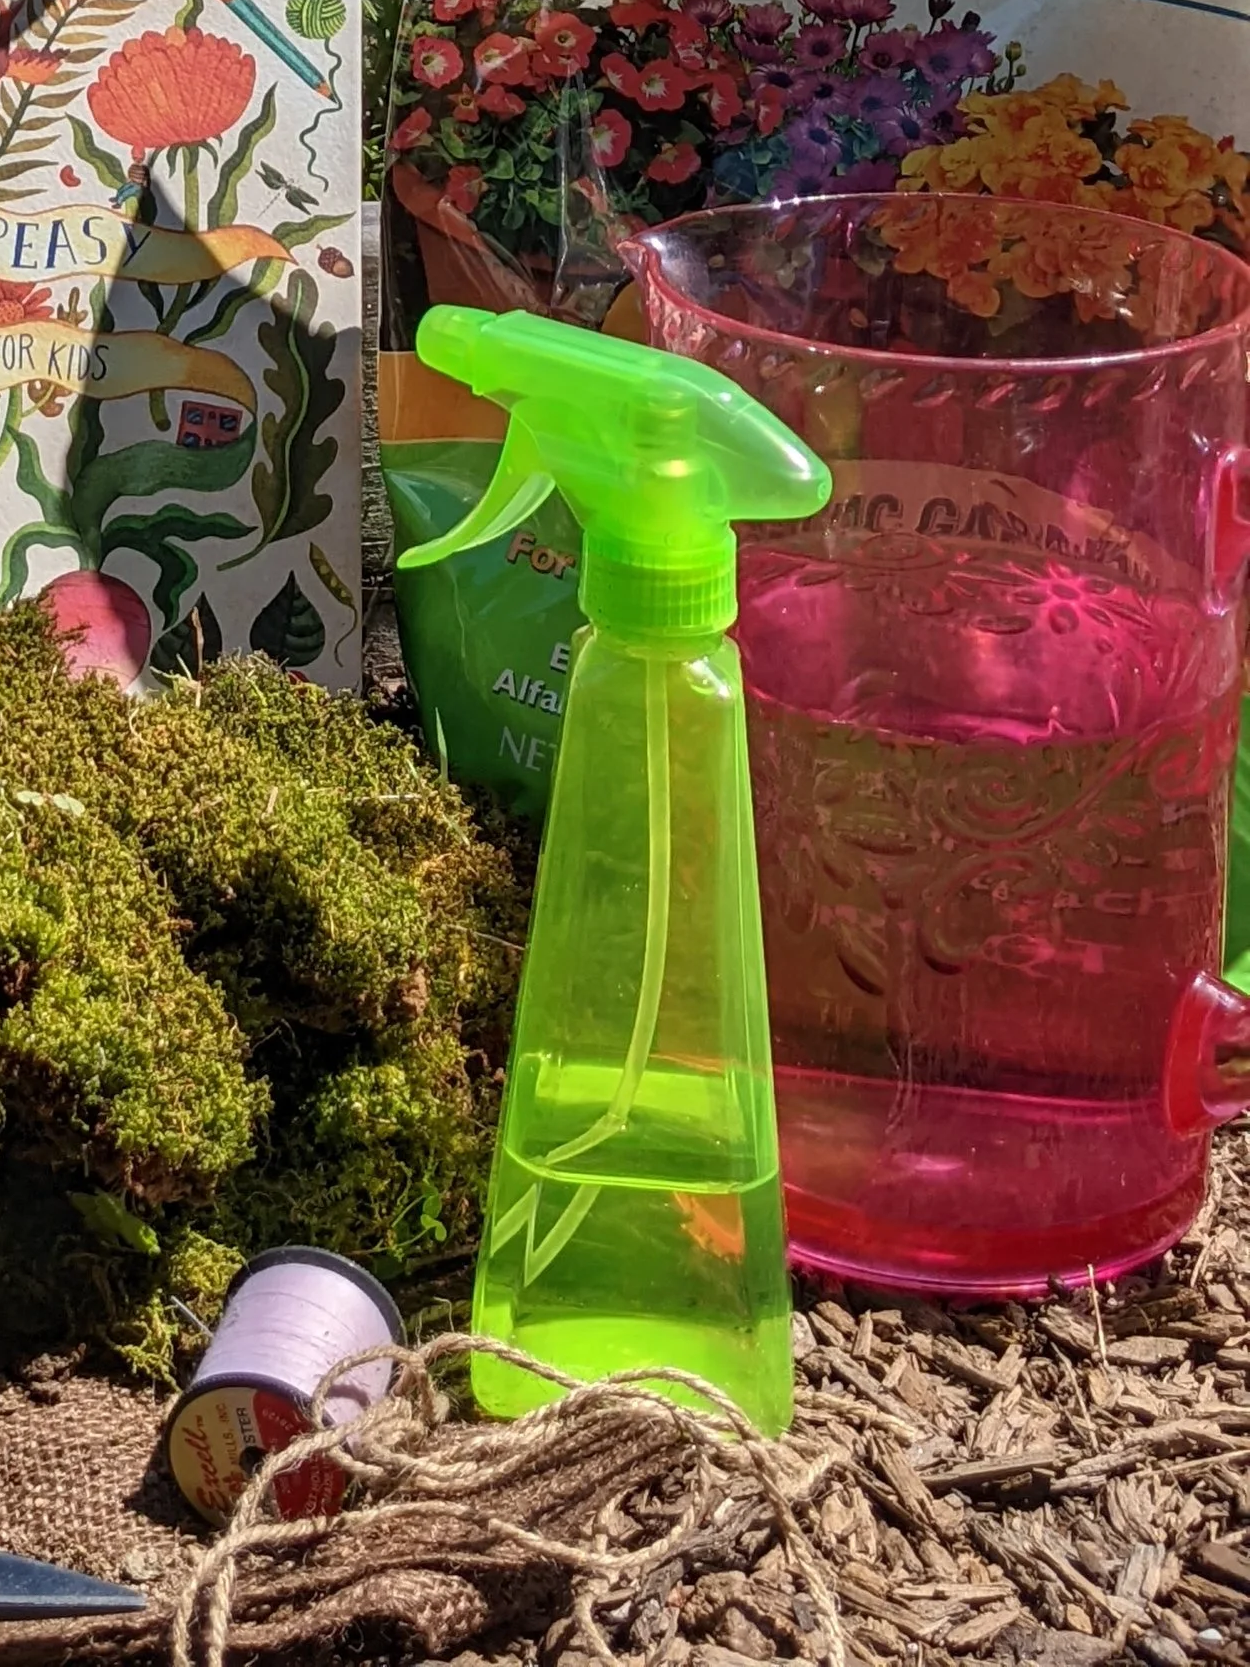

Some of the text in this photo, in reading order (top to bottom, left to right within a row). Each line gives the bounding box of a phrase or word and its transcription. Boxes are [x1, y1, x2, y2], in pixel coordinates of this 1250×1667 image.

[48, 342, 109, 381] KIDS
[507, 531, 576, 579] For
[236, 1406, 257, 1447] STER
[182, 1425, 228, 1512] Excell
